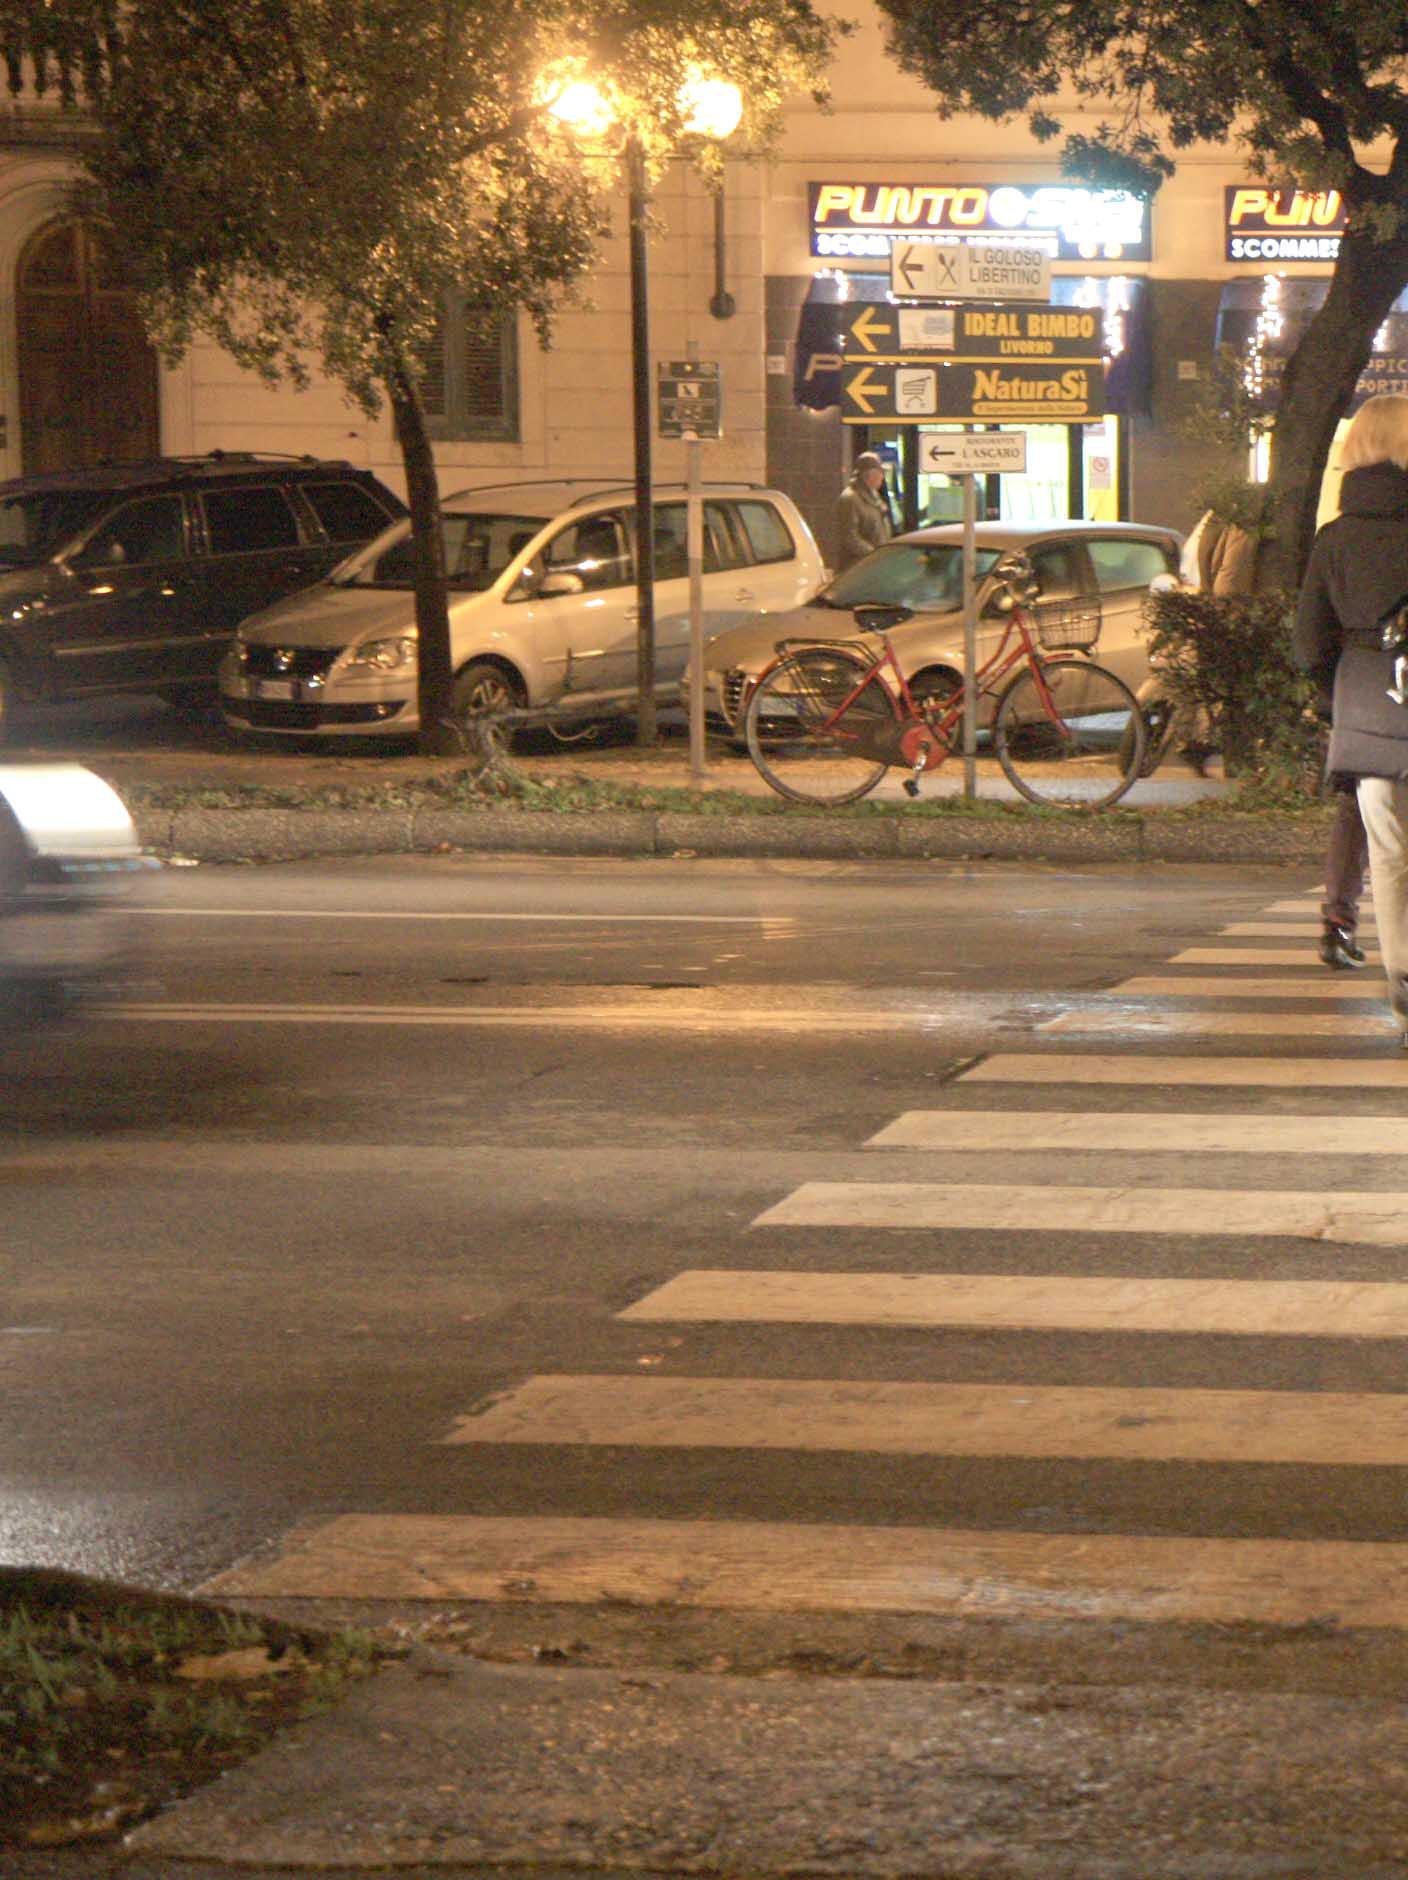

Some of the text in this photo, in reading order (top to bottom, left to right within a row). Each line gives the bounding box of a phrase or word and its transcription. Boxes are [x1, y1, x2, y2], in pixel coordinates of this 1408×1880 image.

[814, 186, 989, 225] PUNTO
[1230, 190, 1341, 226] PUN
[969, 247, 1042, 267] IL GOLOSO
[969, 267, 1041, 285] LIBERTINO
[964, 312, 1094, 338] IDEAL BIMBO
[1001, 340, 1054, 354] LIVORNO
